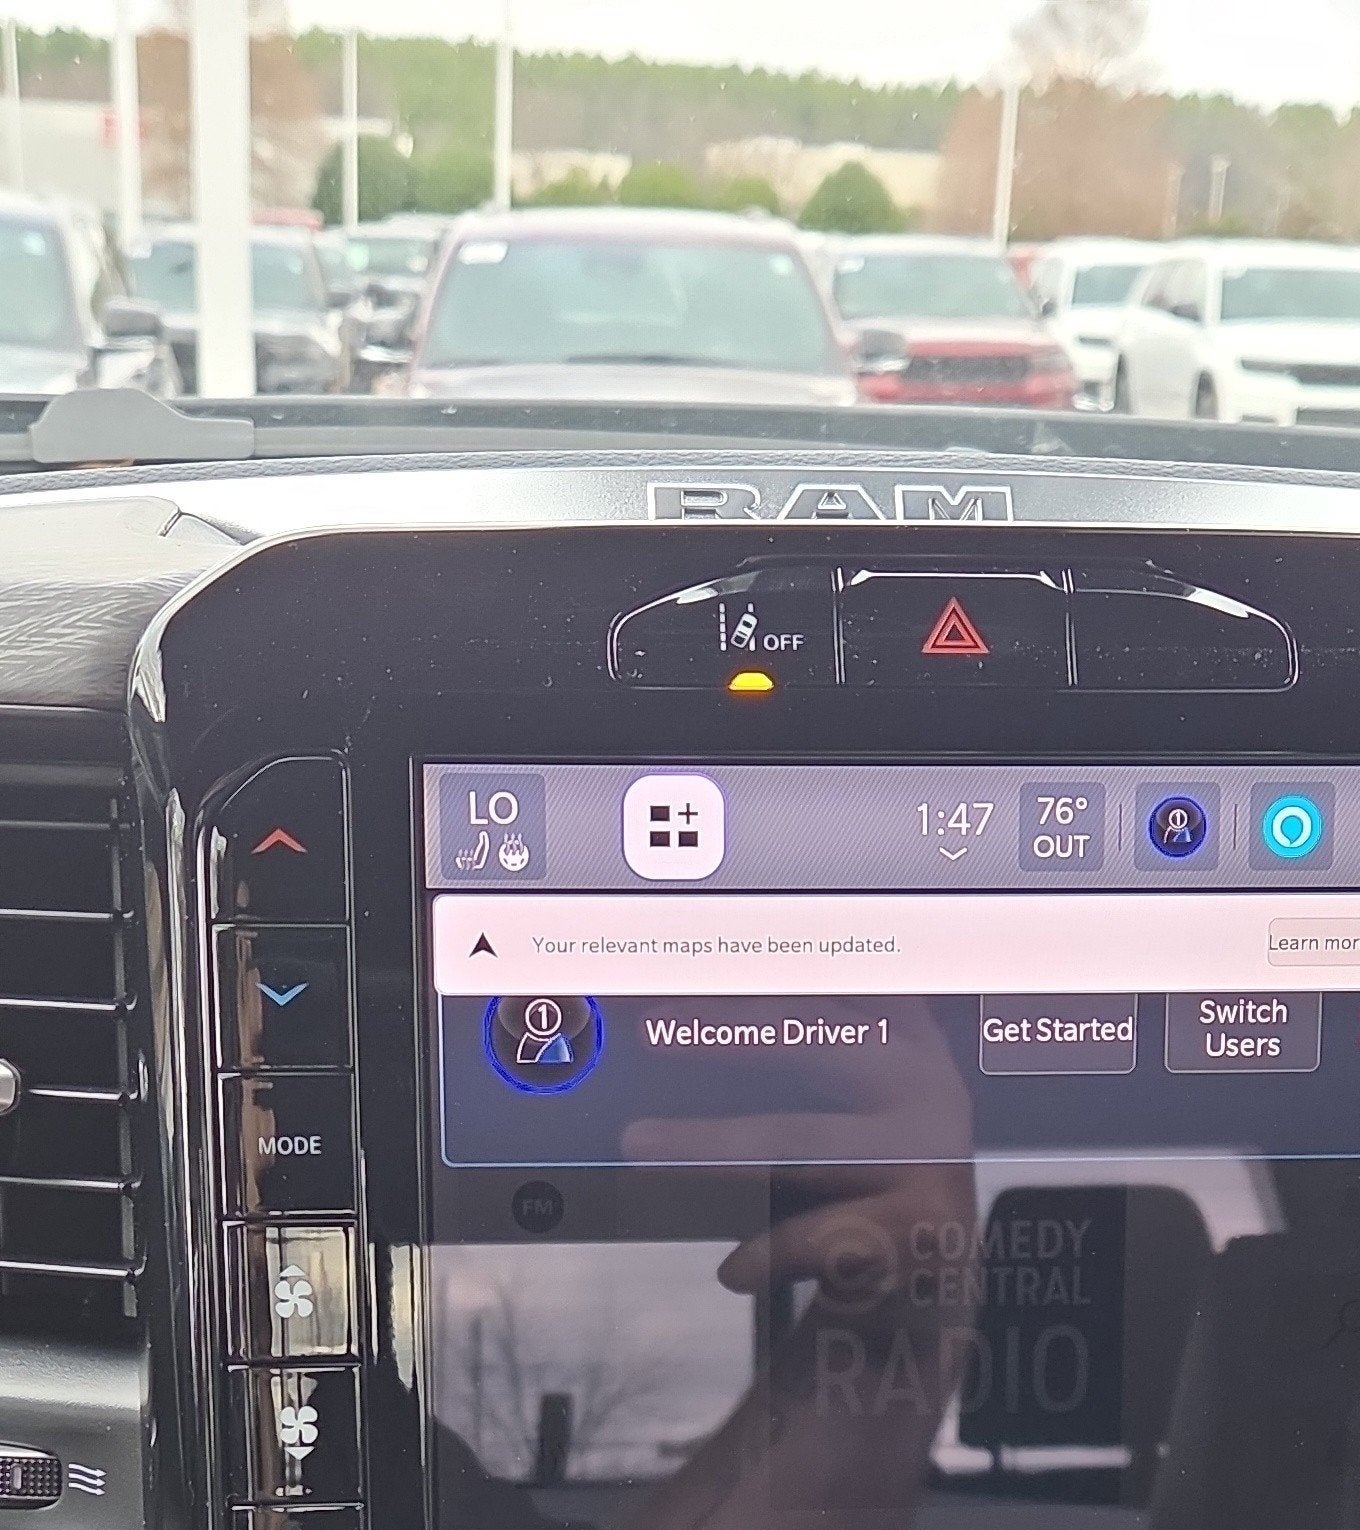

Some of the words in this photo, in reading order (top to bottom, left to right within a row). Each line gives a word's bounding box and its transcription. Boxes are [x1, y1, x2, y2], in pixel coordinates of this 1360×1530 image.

[647, 482, 1014, 521] RAM
[763, 633, 804, 651] OFF
[469, 791, 518, 825] LO
[917, 802, 994, 837] 1:47
[1037, 797, 1088, 825] 76°
[1033, 836, 1090, 859] OUT
[532, 937, 576, 953] Your
[582, 937, 657, 953] relevant
[663, 940, 712, 957] maps
[718, 936, 762, 953] have
[768, 936, 813, 953] been
[819, 936, 901, 957] updated.
[1269, 935, 1319, 951] Learn
[1199, 999, 1287, 1024] Switch
[646, 1019, 776, 1045] Welcome
[784, 1019, 868, 1045] Driver
[877, 1019, 888, 1043] 1
[983, 1019, 1031, 1042] Get
[1036, 1017, 1133, 1042] Started
[1205, 1033, 1281, 1057] Users
[258, 1136, 321, 1155] MODE
[910, 1219, 1090, 1260] COMEDY
[910, 1267, 1090, 1305] CENTRAL
[816, 1326, 1090, 1414] RADIO
